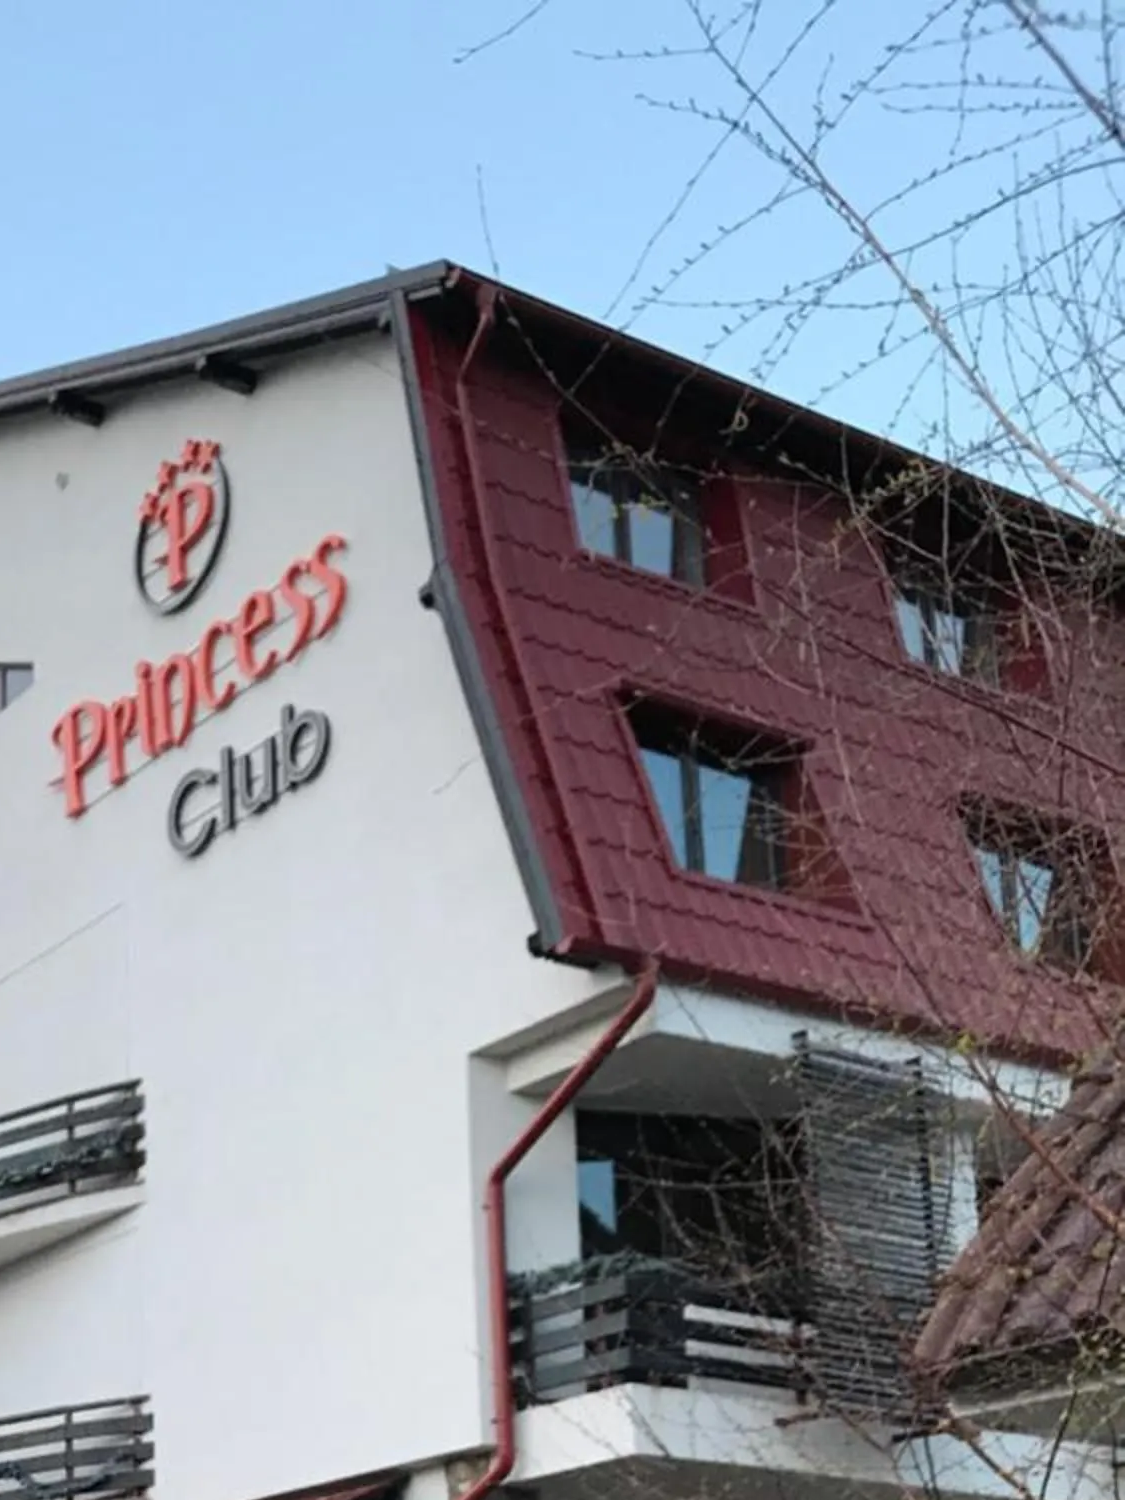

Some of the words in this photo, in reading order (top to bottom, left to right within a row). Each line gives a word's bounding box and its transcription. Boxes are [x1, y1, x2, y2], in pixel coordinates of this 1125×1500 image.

[159, 482, 216, 592] P
[49, 534, 349, 821] Princess
[168, 703, 332, 858] Club
